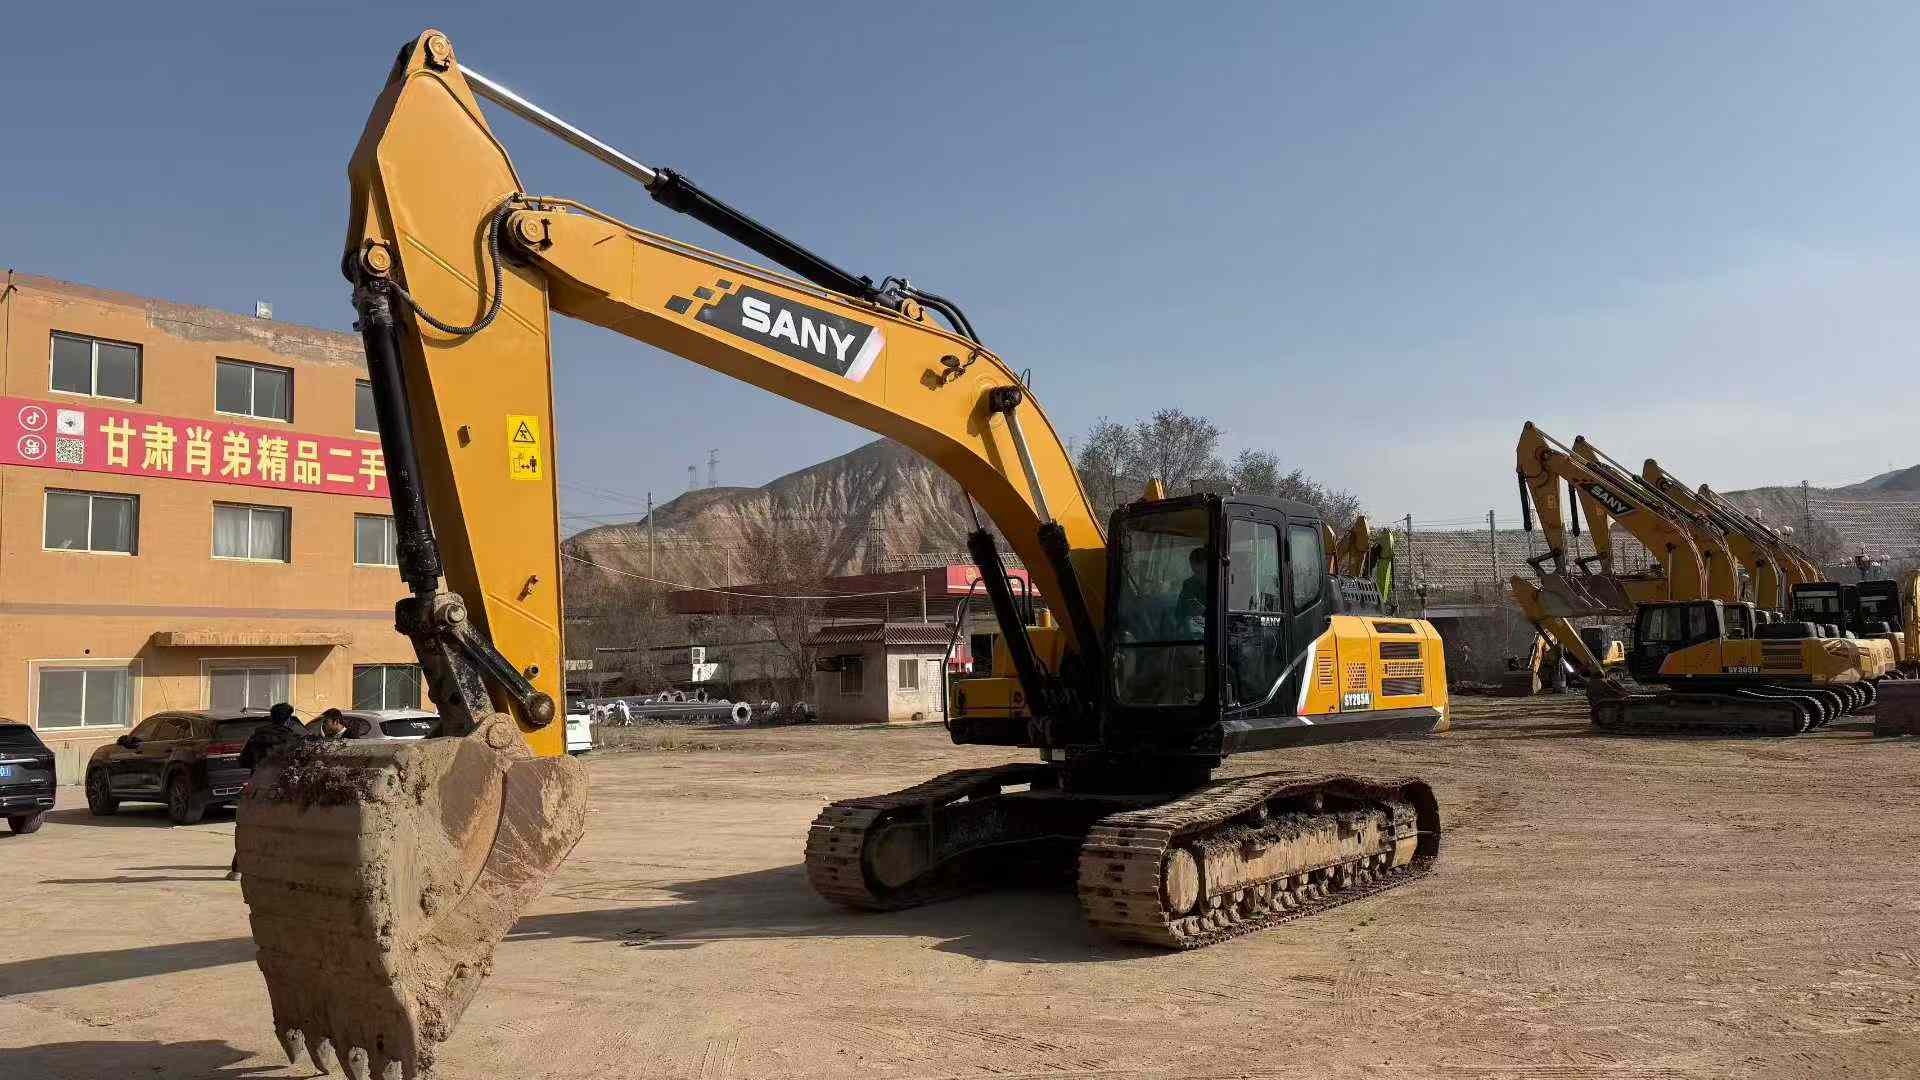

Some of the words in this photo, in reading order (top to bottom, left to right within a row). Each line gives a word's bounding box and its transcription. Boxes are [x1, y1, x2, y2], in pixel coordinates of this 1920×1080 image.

[741, 296, 856, 361] SANY
[99, 416, 387, 491] 甘肃肖弟精品二手
[1591, 485, 1627, 512] SANY
